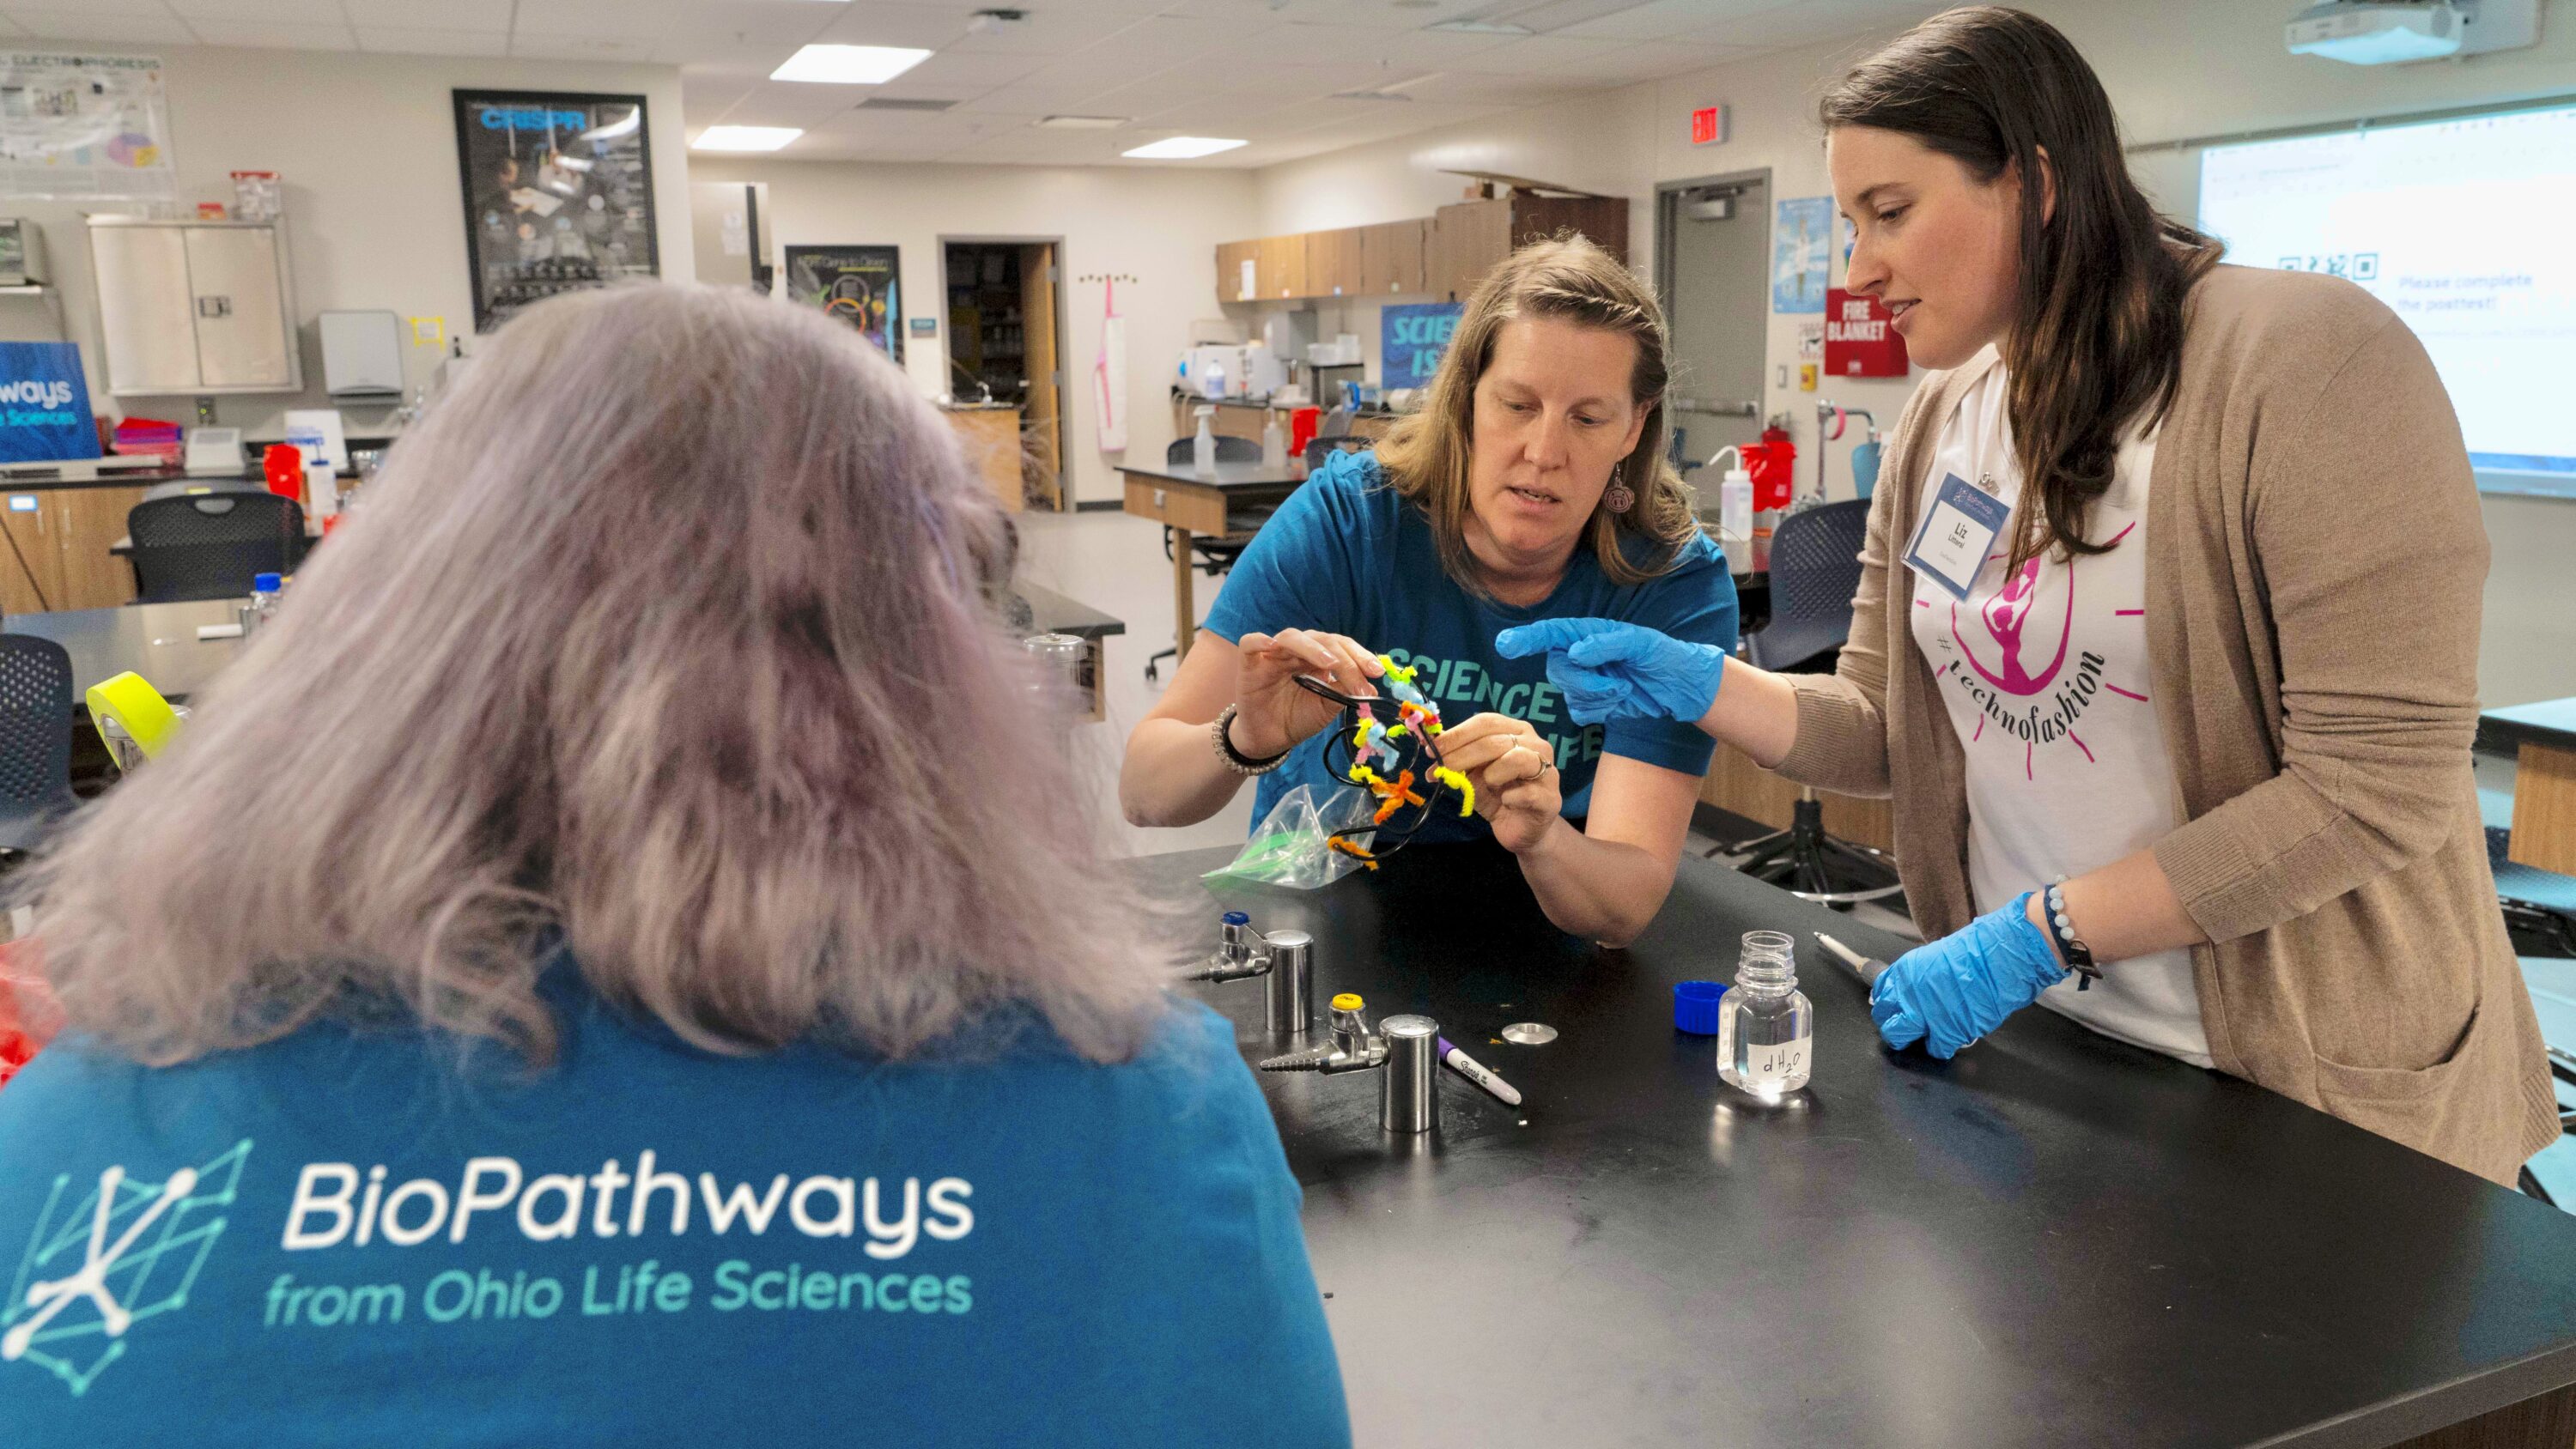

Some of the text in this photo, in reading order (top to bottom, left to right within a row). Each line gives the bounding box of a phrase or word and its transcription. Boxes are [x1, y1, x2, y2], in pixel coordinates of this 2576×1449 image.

[12, 55, 161, 70] ELECTRPHORESIS
[480, 108, 586, 130] CRISPR
[2399, 272, 2532, 290] Please complete
[1842, 300, 1870, 320] FIRE
[1391, 315, 1461, 344] SCIE
[1827, 320, 1886, 342] BLANKET
[1411, 349, 1439, 377] IS
[1954, 522, 1968, 540] Liz
[1546, 725, 1603, 770] IFE
[281, 1148, 975, 1260] BioPathways
[264, 1258, 974, 1330] from Ohio Life Sciences
